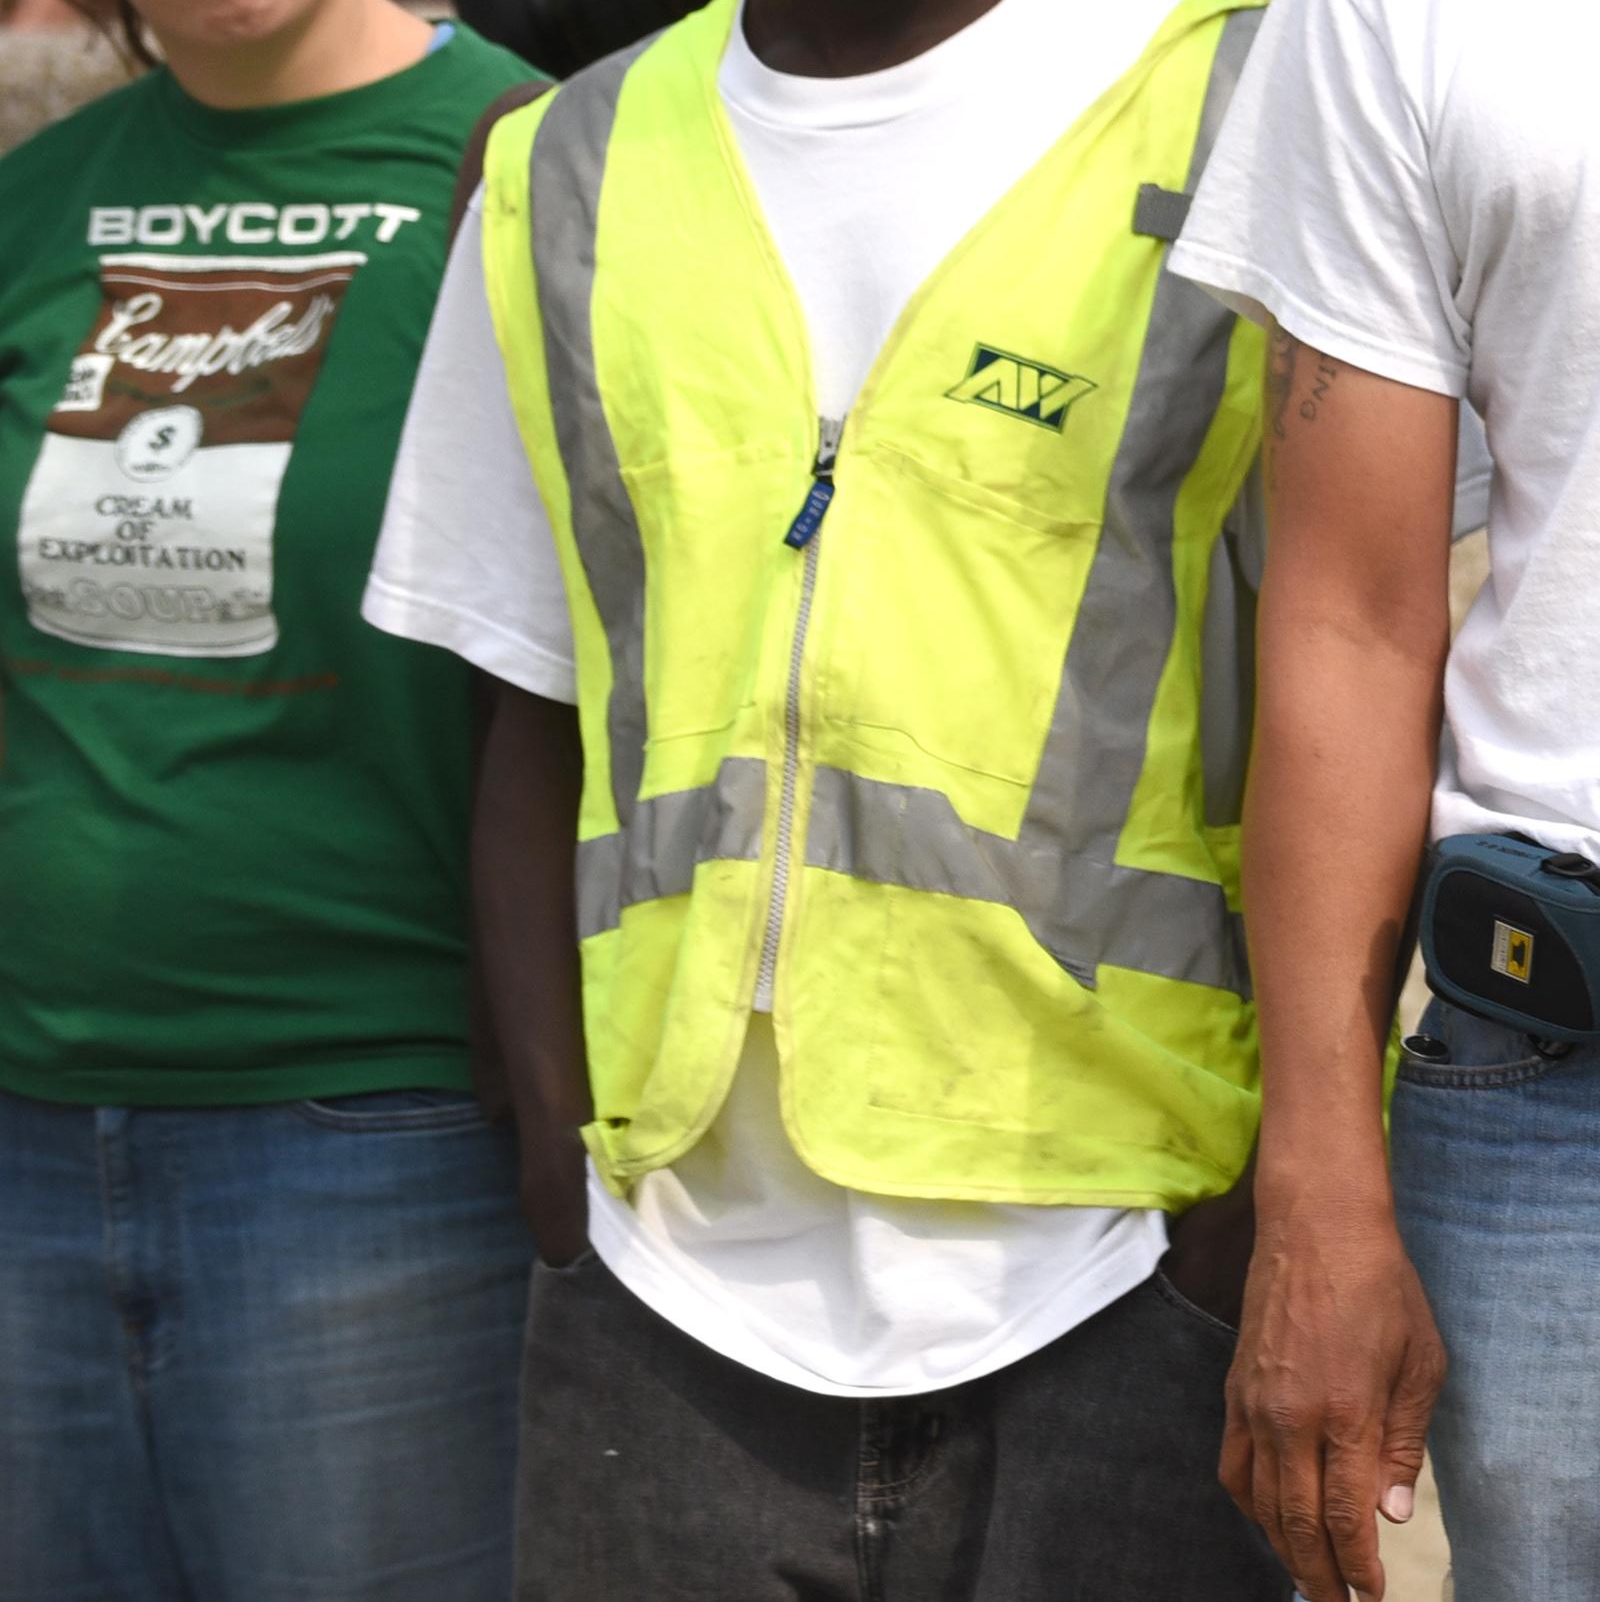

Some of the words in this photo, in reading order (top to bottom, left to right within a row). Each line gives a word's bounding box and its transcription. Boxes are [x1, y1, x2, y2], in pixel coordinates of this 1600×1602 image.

[87, 202, 421, 246] BOYCOTT
[95, 494, 194, 520] CREAM
[115, 520, 156, 542] OF
[38, 538, 247, 572] EXPLOITATION
